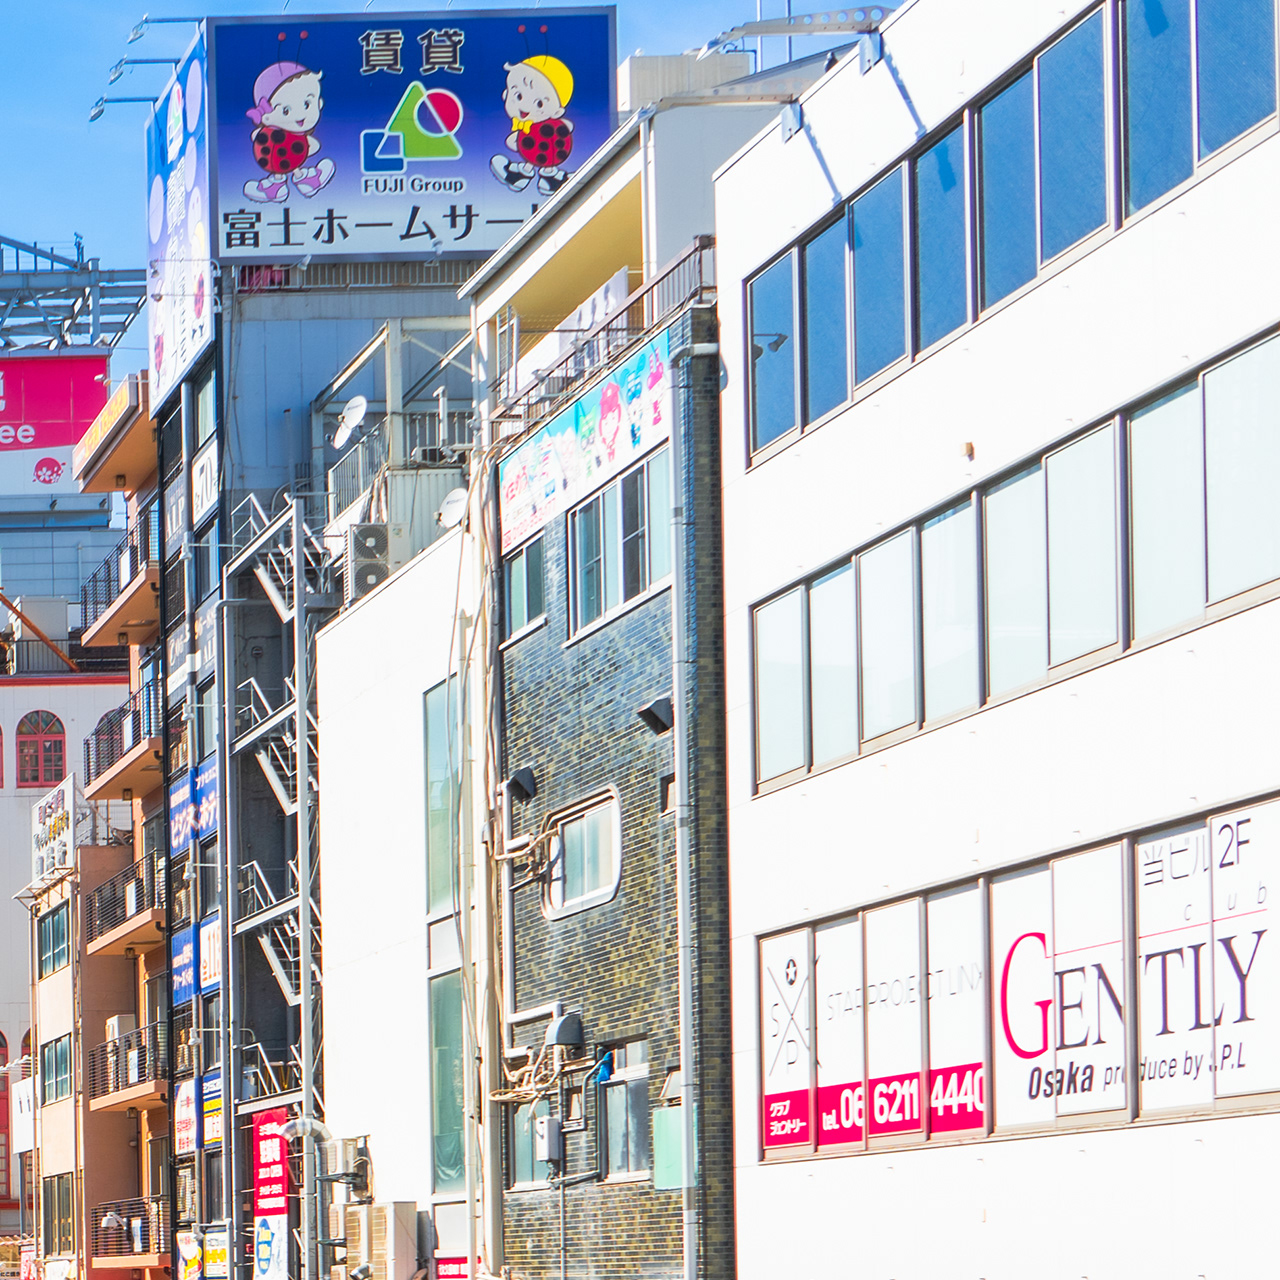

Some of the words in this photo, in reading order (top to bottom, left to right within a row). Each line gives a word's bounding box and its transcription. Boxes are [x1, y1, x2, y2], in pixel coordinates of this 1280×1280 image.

[358, 28, 466, 76] 賃貸
[362, 177, 405, 194] FUJI
[410, 176, 465, 195] Group
[223, 203, 538, 249] 富士ホームサー
[1218, 818, 1251, 869] 2F
[1029, 1061, 1095, 1100] Osaka
[1183, 1050, 1204, 1080] by
[770, 1100, 790, 1117] クラブ
[840, 1086, 864, 1128] 06
[874, 1078, 919, 1124] 6211
[770, 1118, 807, 1136] ジェントリー
